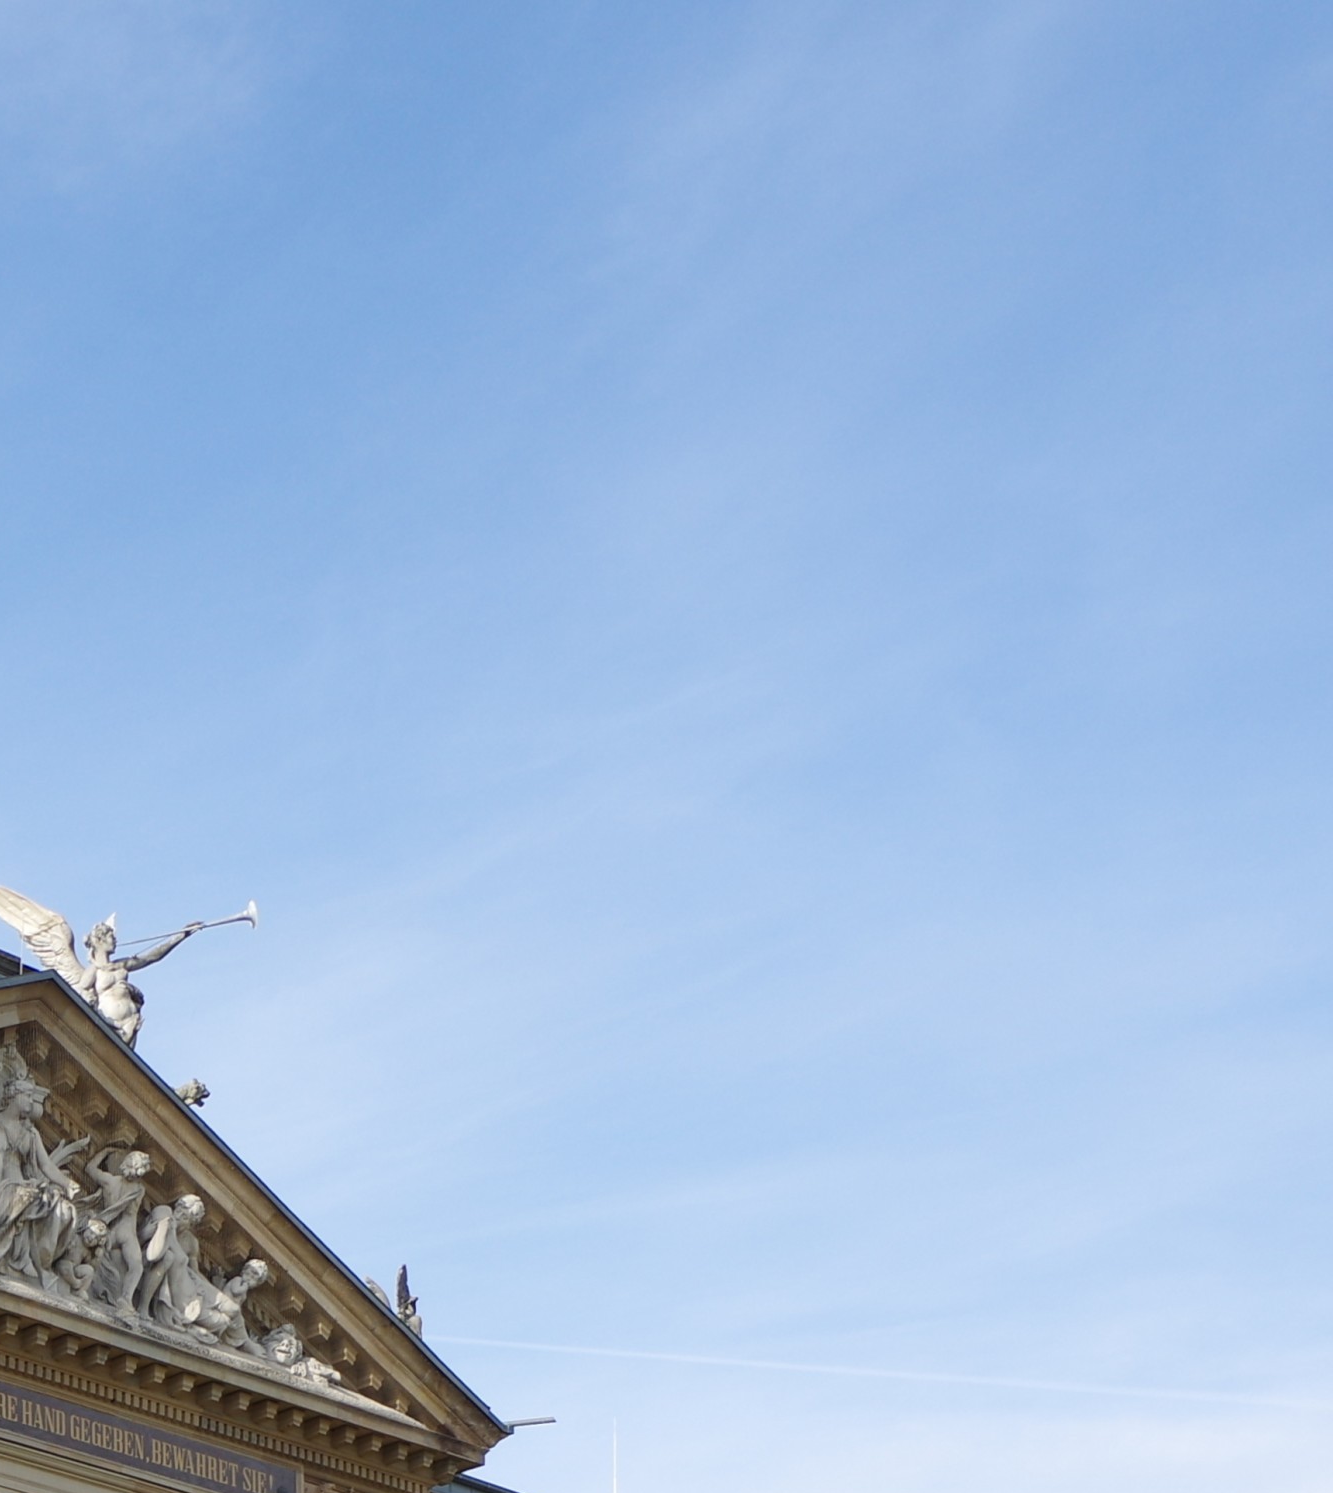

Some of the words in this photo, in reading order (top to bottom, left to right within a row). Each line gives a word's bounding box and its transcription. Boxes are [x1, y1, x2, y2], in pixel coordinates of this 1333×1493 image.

[22, 1399, 66, 1437] HAND
[70, 1414, 150, 1464] GEGEBEN,
[151, 1438, 239, 1488] BEWAHRET
